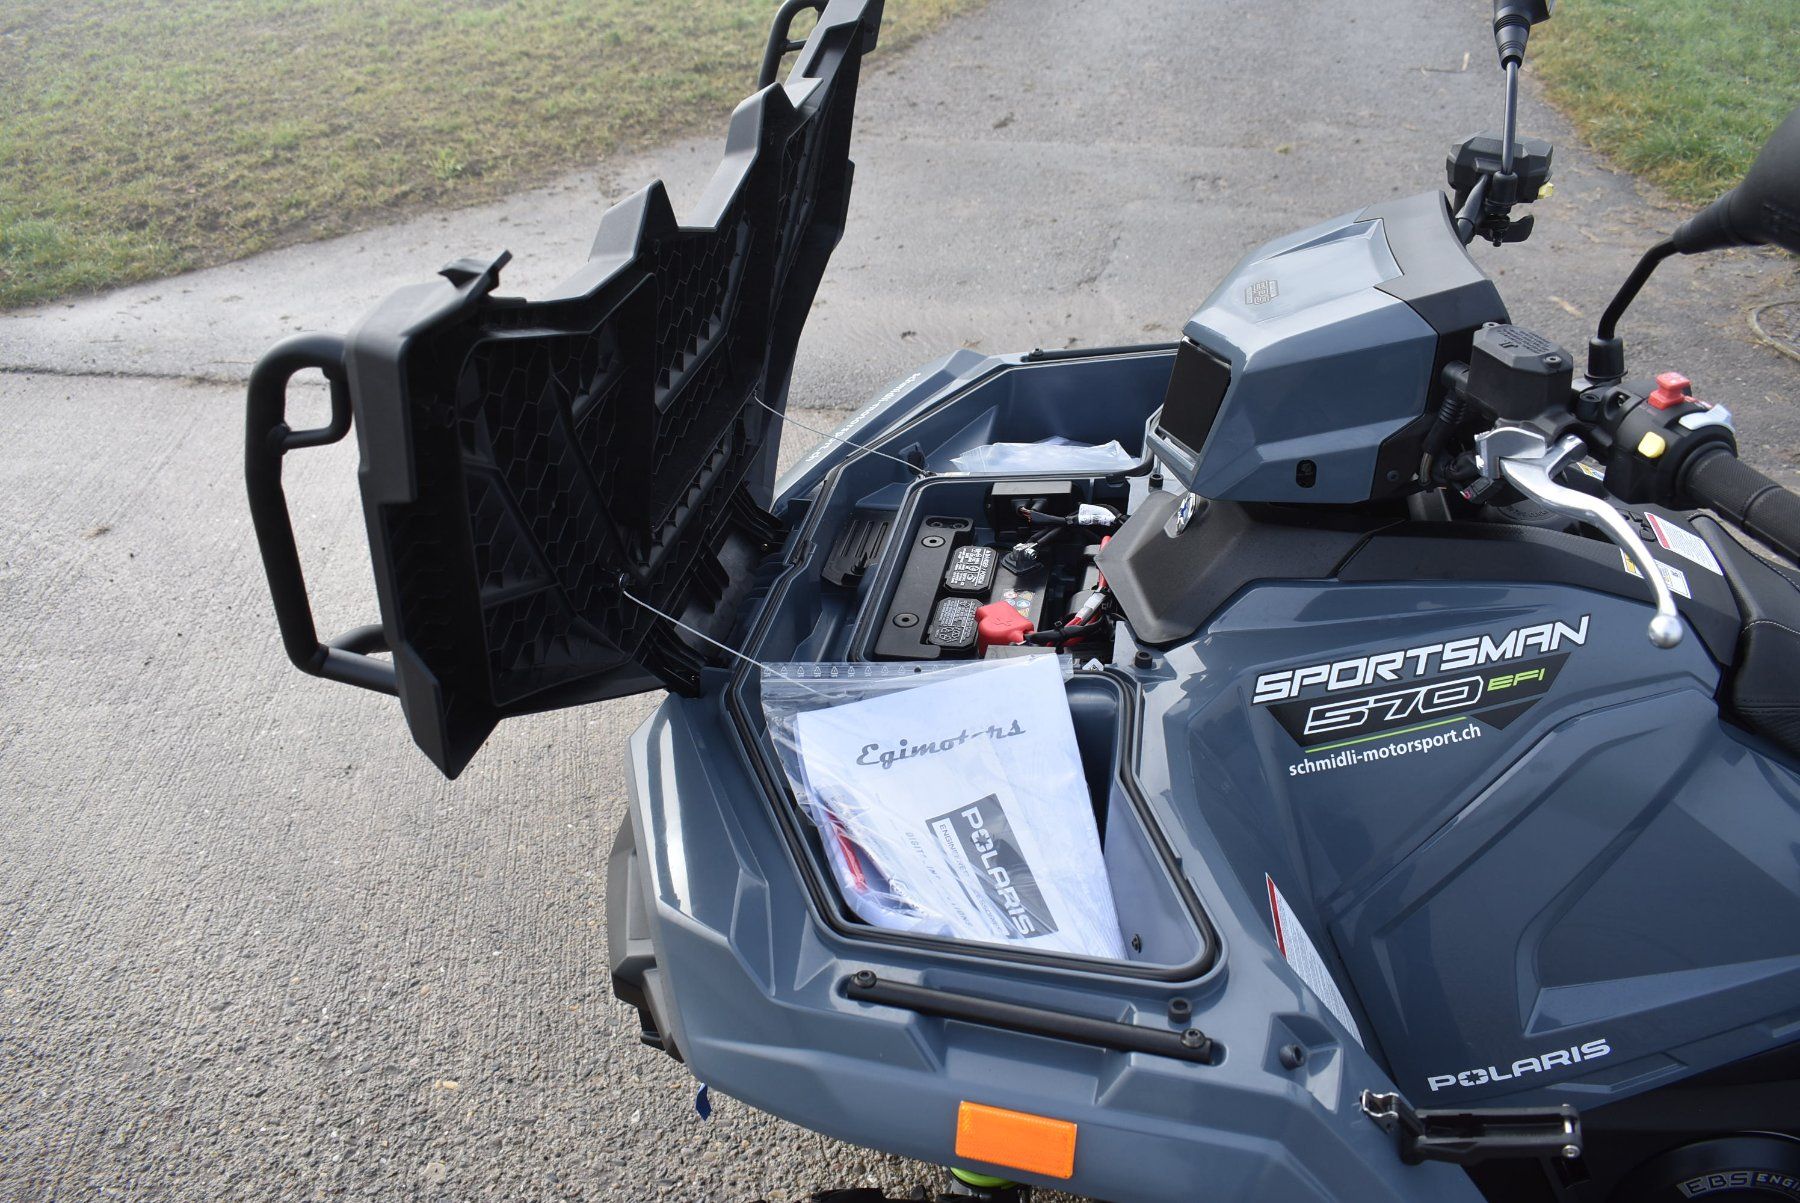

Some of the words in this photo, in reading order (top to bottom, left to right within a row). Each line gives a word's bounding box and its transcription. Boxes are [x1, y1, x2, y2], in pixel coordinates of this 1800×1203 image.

[1253, 615, 1590, 703] SPORTSMAN
[1303, 675, 1484, 735] 570
[1487, 668, 1546, 692] EFI
[856, 719, 1026, 769] Egimotrs
[1289, 723, 1481, 776] schmidli-motorsport.ch
[961, 806, 1035, 935] POLARIS
[1427, 1038, 1611, 1092] POLARIS
[1683, 1172, 1749, 1194] EBS
